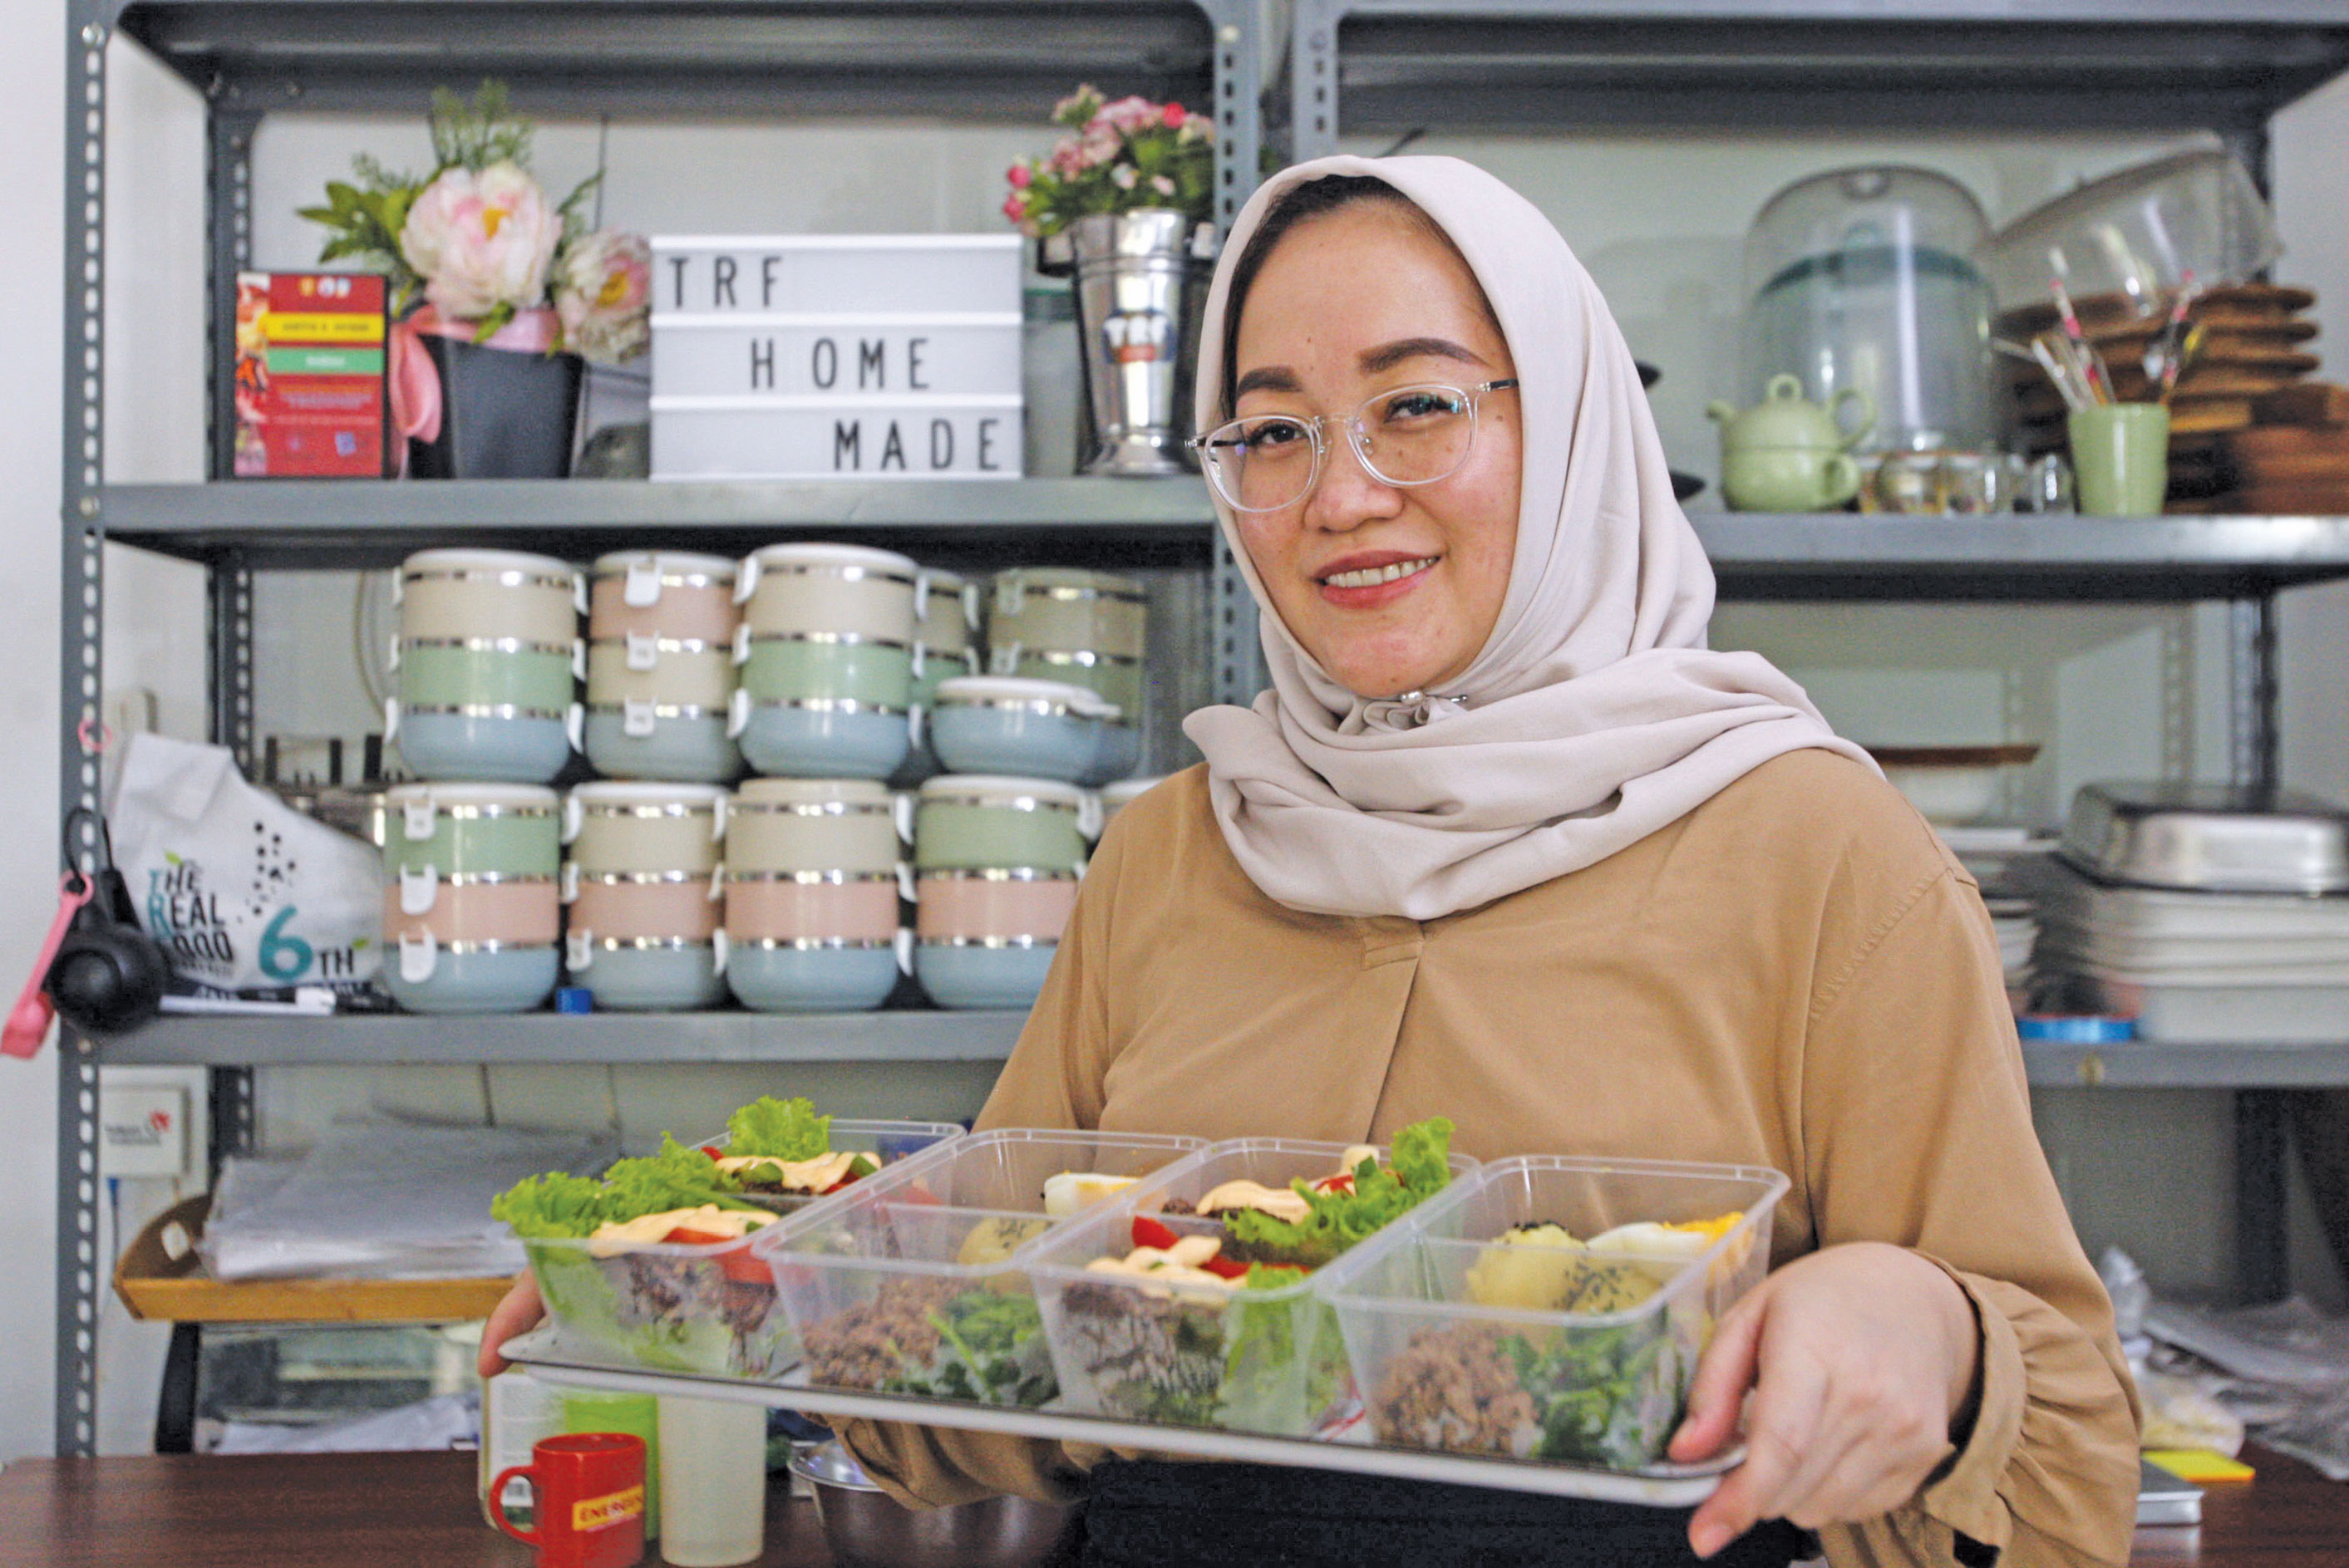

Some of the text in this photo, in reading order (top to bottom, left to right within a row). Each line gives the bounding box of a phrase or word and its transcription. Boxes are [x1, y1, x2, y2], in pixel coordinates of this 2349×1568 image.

[668, 256, 782, 307] TRF
[751, 338, 930, 390] HOME
[834, 419, 1000, 470] MADE
[148, 862, 201, 895] THE
[148, 892, 225, 937] REAL
[169, 930, 235, 963] OOD
